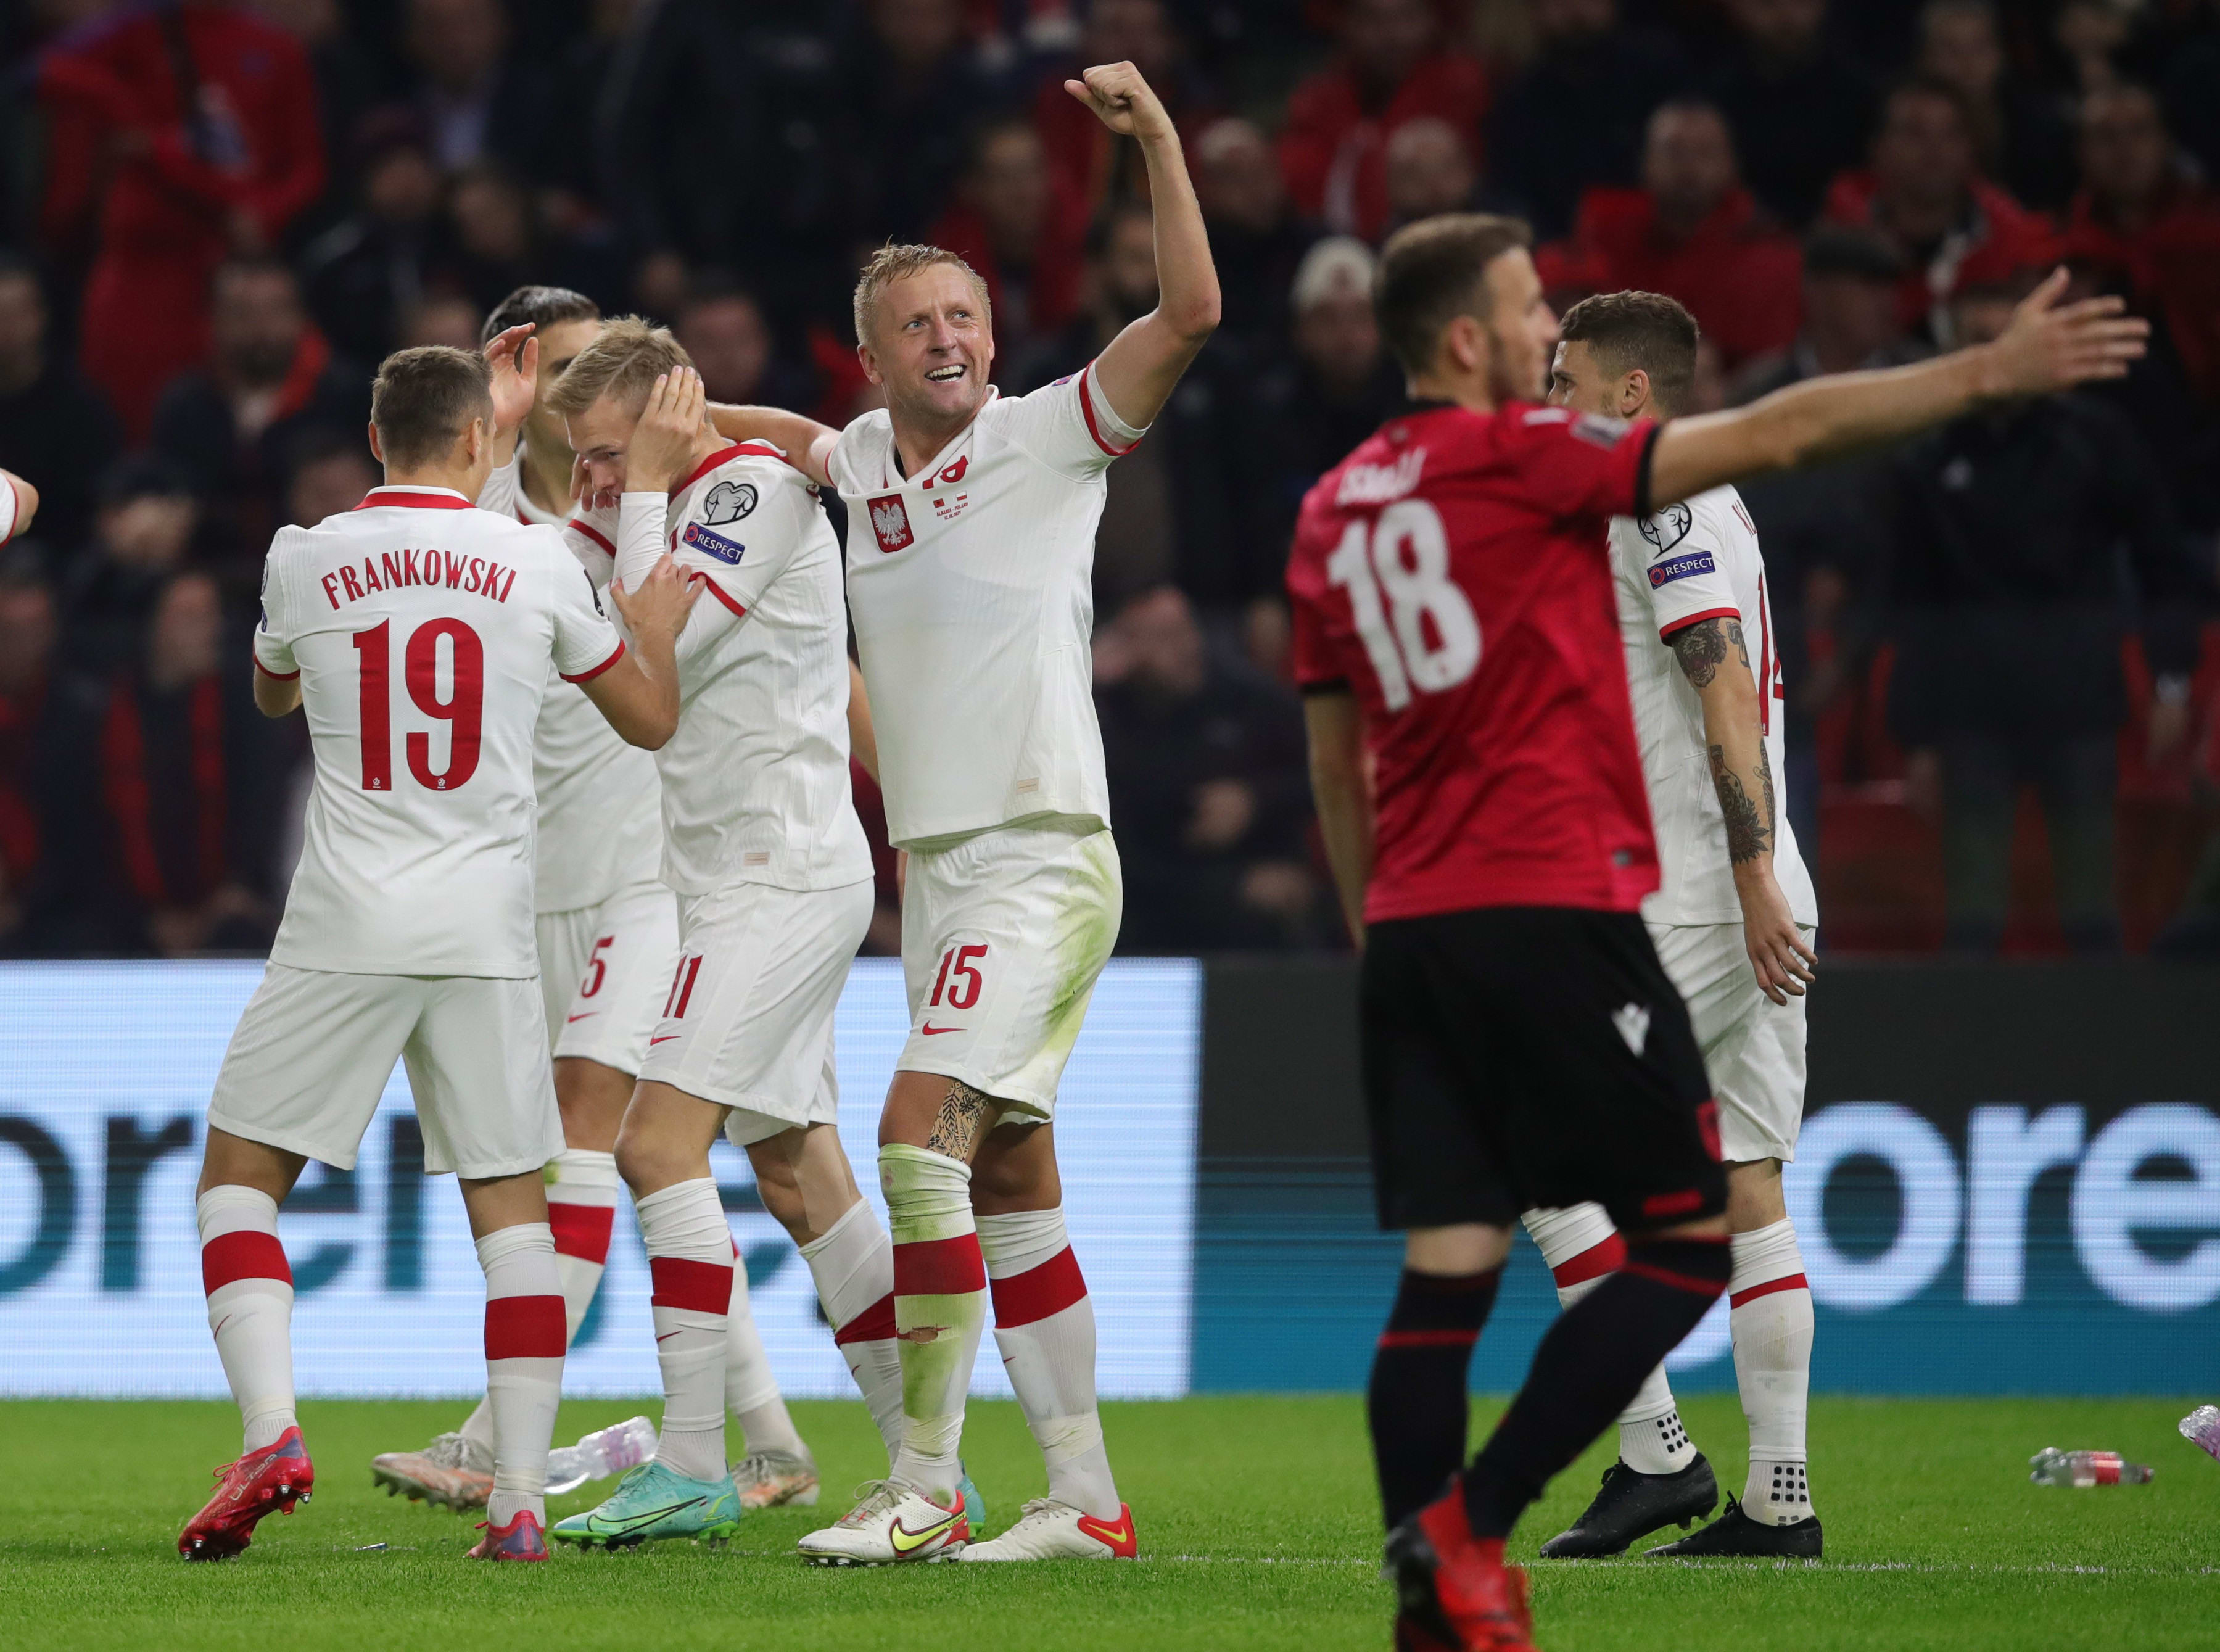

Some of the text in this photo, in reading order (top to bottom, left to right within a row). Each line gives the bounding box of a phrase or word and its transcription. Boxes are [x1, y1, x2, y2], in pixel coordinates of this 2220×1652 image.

[697, 534, 743, 560] RESPECT
[1665, 557, 1712, 576] RESPECT
[321, 549, 516, 611] FRANKOWSKI
[1327, 498, 1480, 712] 18
[353, 617, 484, 791] 19
[582, 935, 614, 999] 5
[662, 954, 703, 1019] 11
[930, 944, 988, 1009] 15
